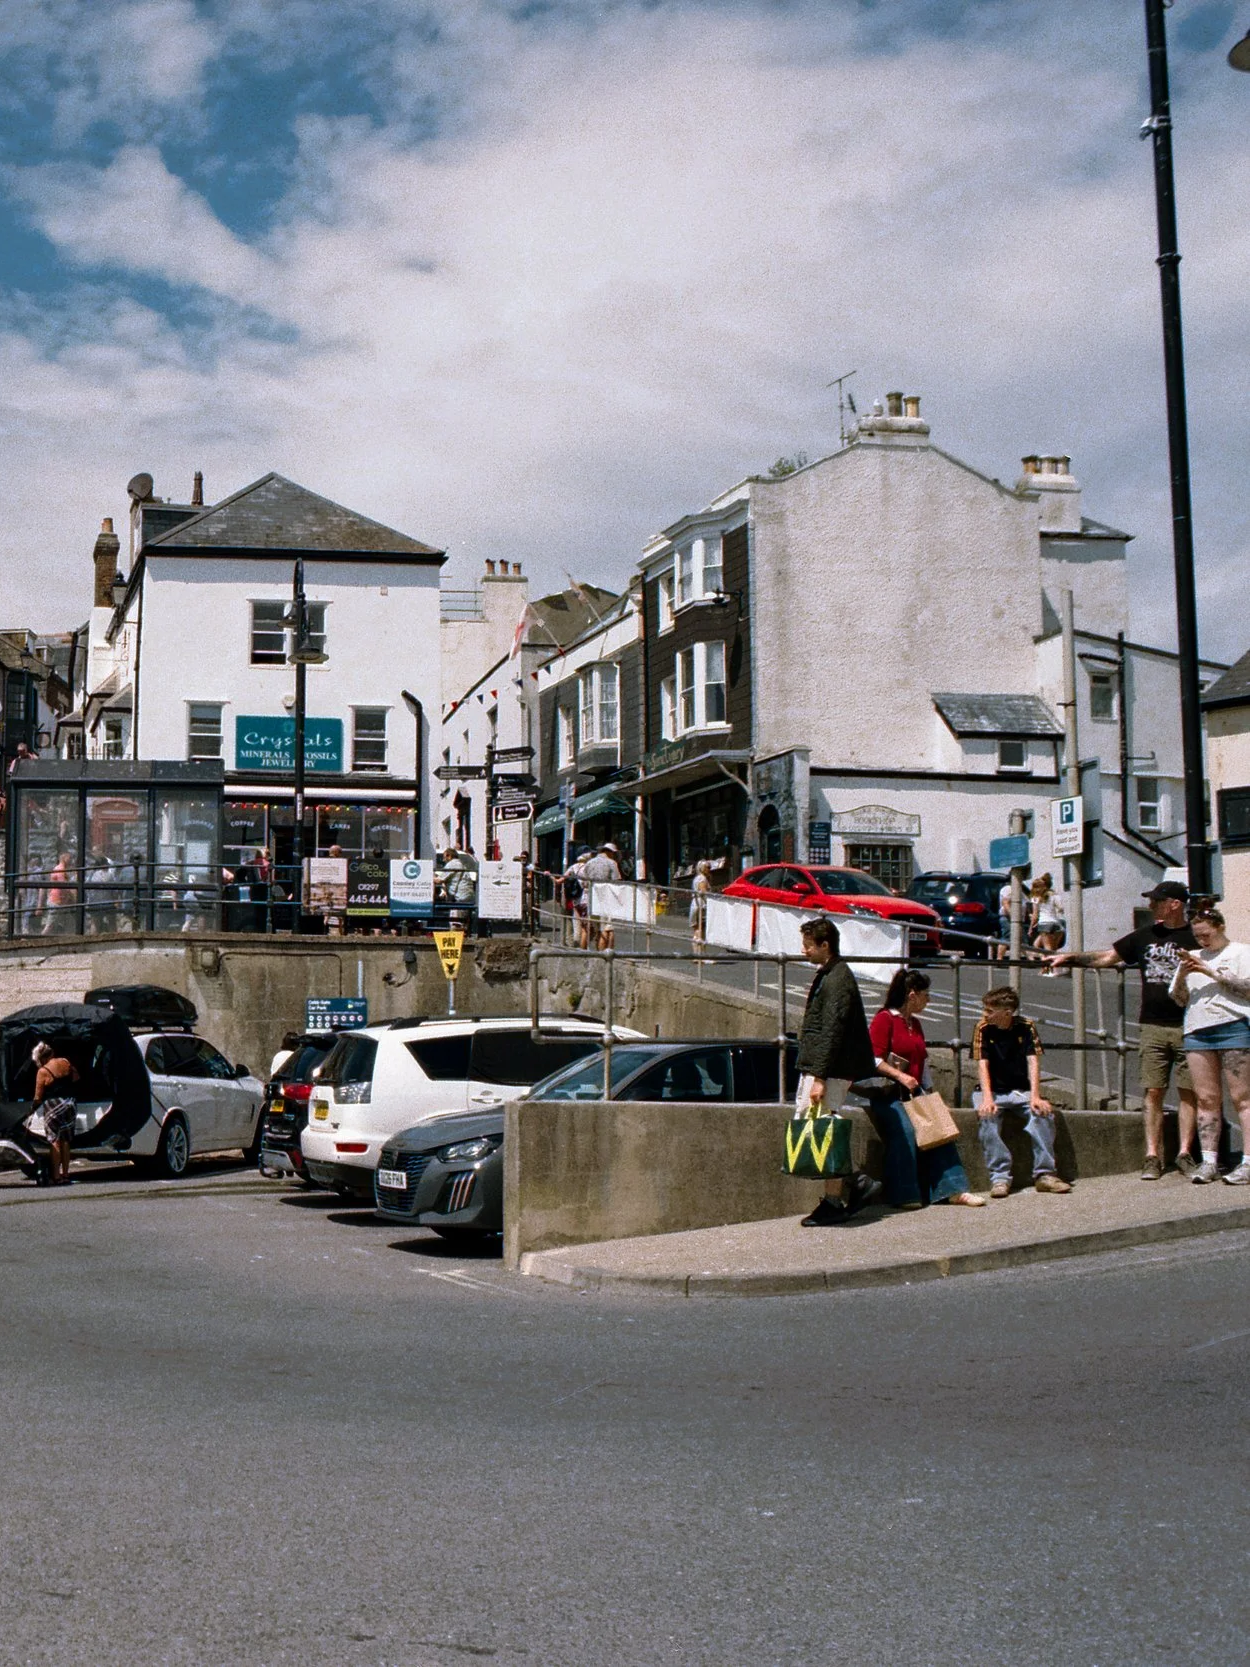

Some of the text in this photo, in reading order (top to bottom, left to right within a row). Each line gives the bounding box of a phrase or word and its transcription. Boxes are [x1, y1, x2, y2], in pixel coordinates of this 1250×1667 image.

[243, 731, 333, 750] Crysals
[240, 750, 338, 760] MINERALS OSSILS
[260, 759, 316, 768] JEWELLRY
[1062, 803, 1072, 822] P
[230, 820, 255, 828] COFFEE
[358, 883, 379, 891] 01297
[349, 895, 388, 904] 445 444
[442, 937, 456, 947] PAY
[441, 950, 460, 959] HERE
